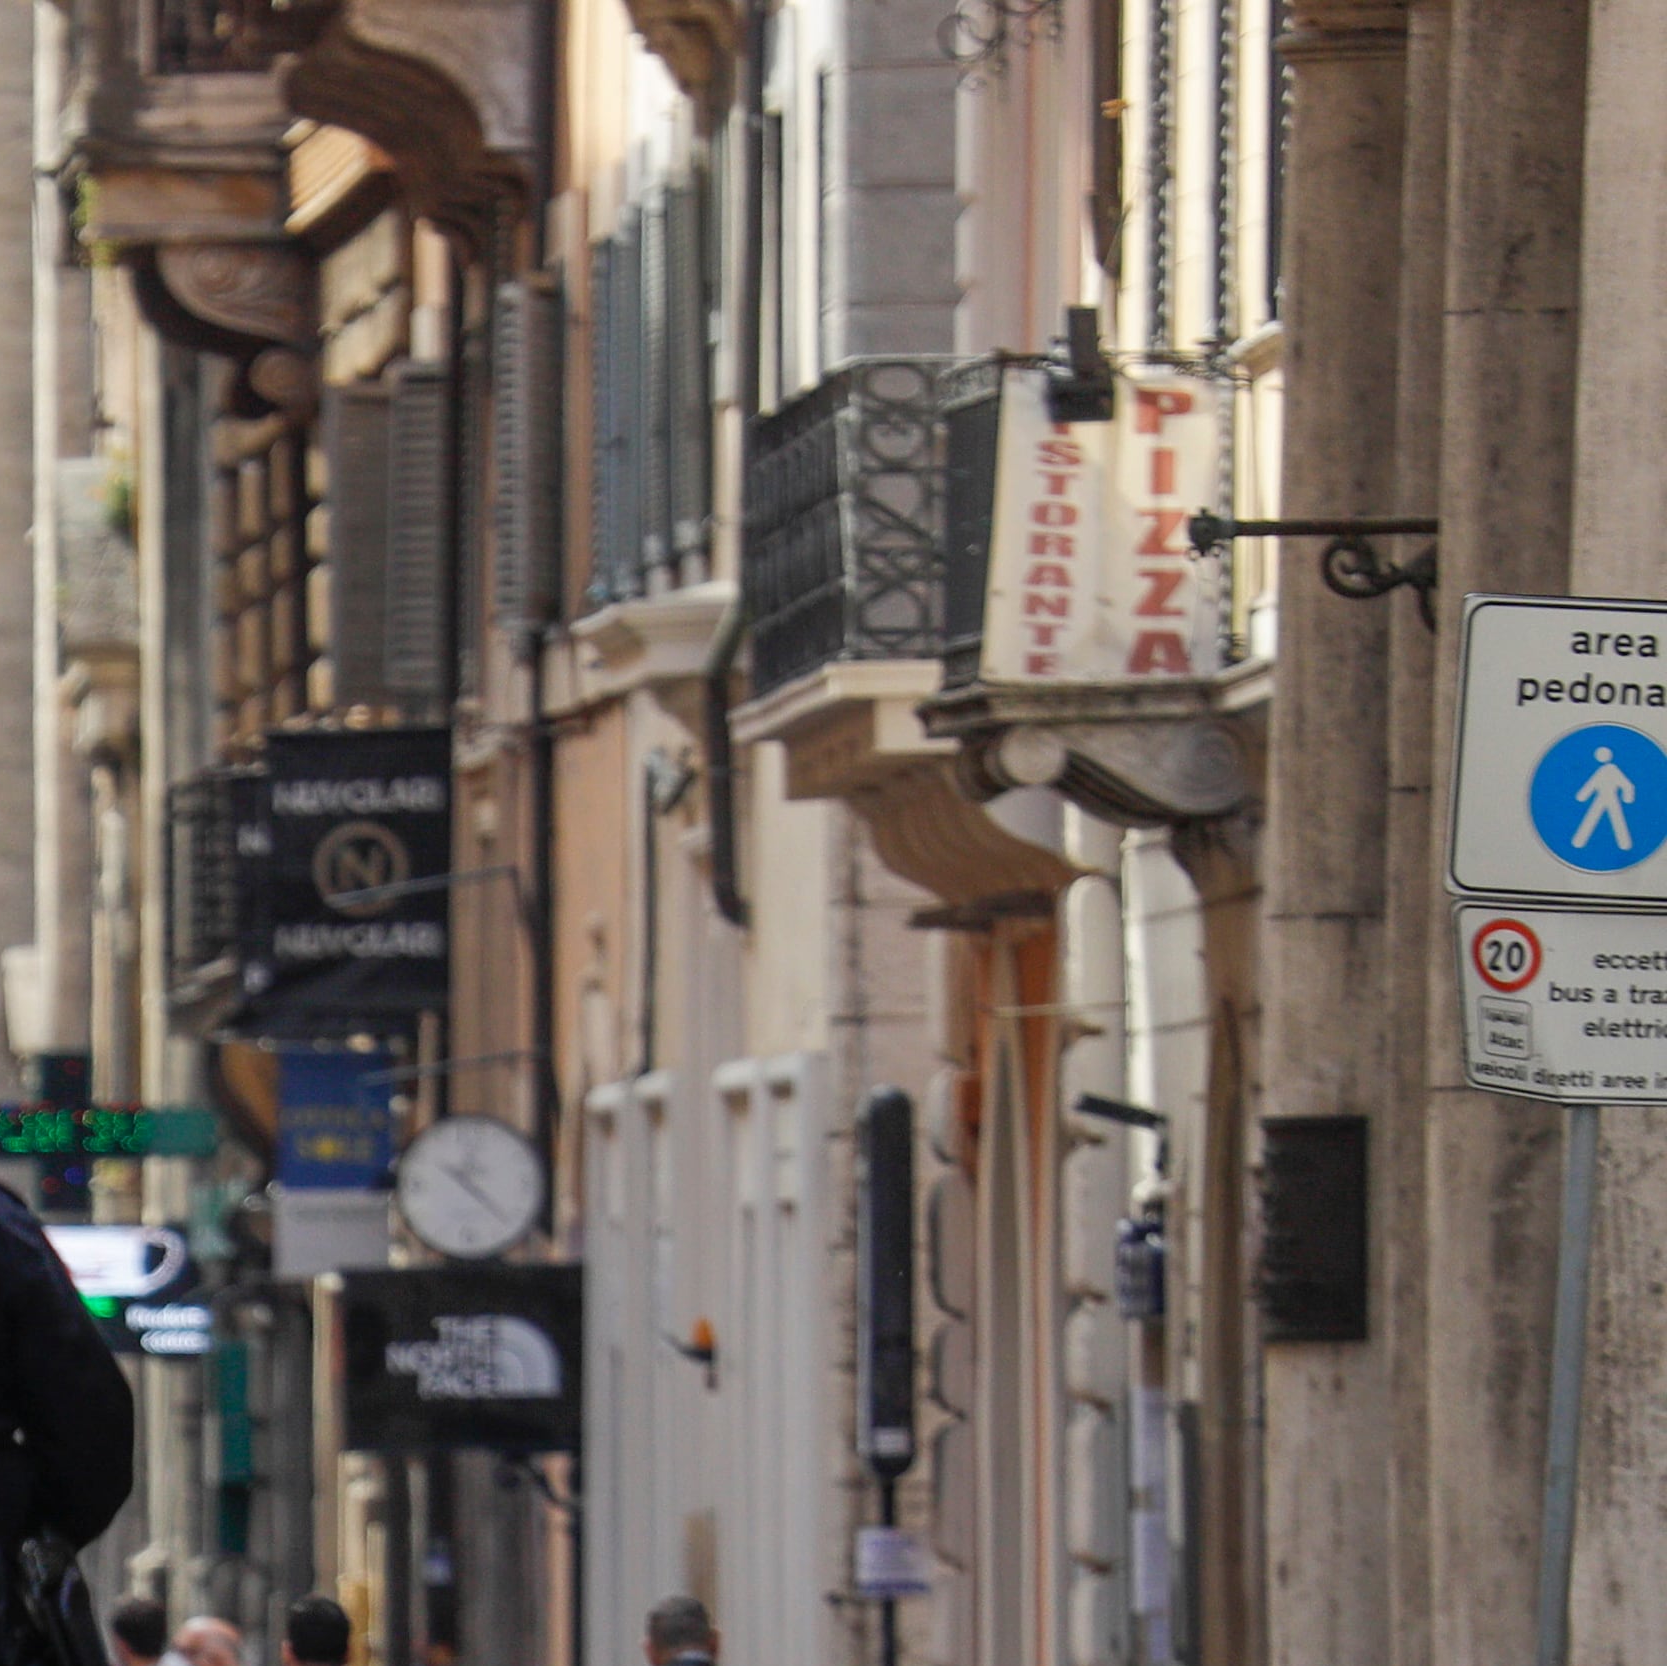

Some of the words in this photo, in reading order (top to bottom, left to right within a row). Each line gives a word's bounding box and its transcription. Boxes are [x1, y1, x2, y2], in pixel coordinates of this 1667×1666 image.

[1128, 386, 1195, 675] PIZZA
[1022, 421, 1084, 675] STORANTE
[1570, 630, 1659, 657] area
[1486, 939, 1526, 973] 20
[1547, 981, 1594, 1002] bus
[1602, 987, 1619, 1004] a
[1473, 1060, 1528, 1081] veicoli
[1532, 1066, 1594, 1088] diretti
[1600, 1072, 1647, 1089] aree
